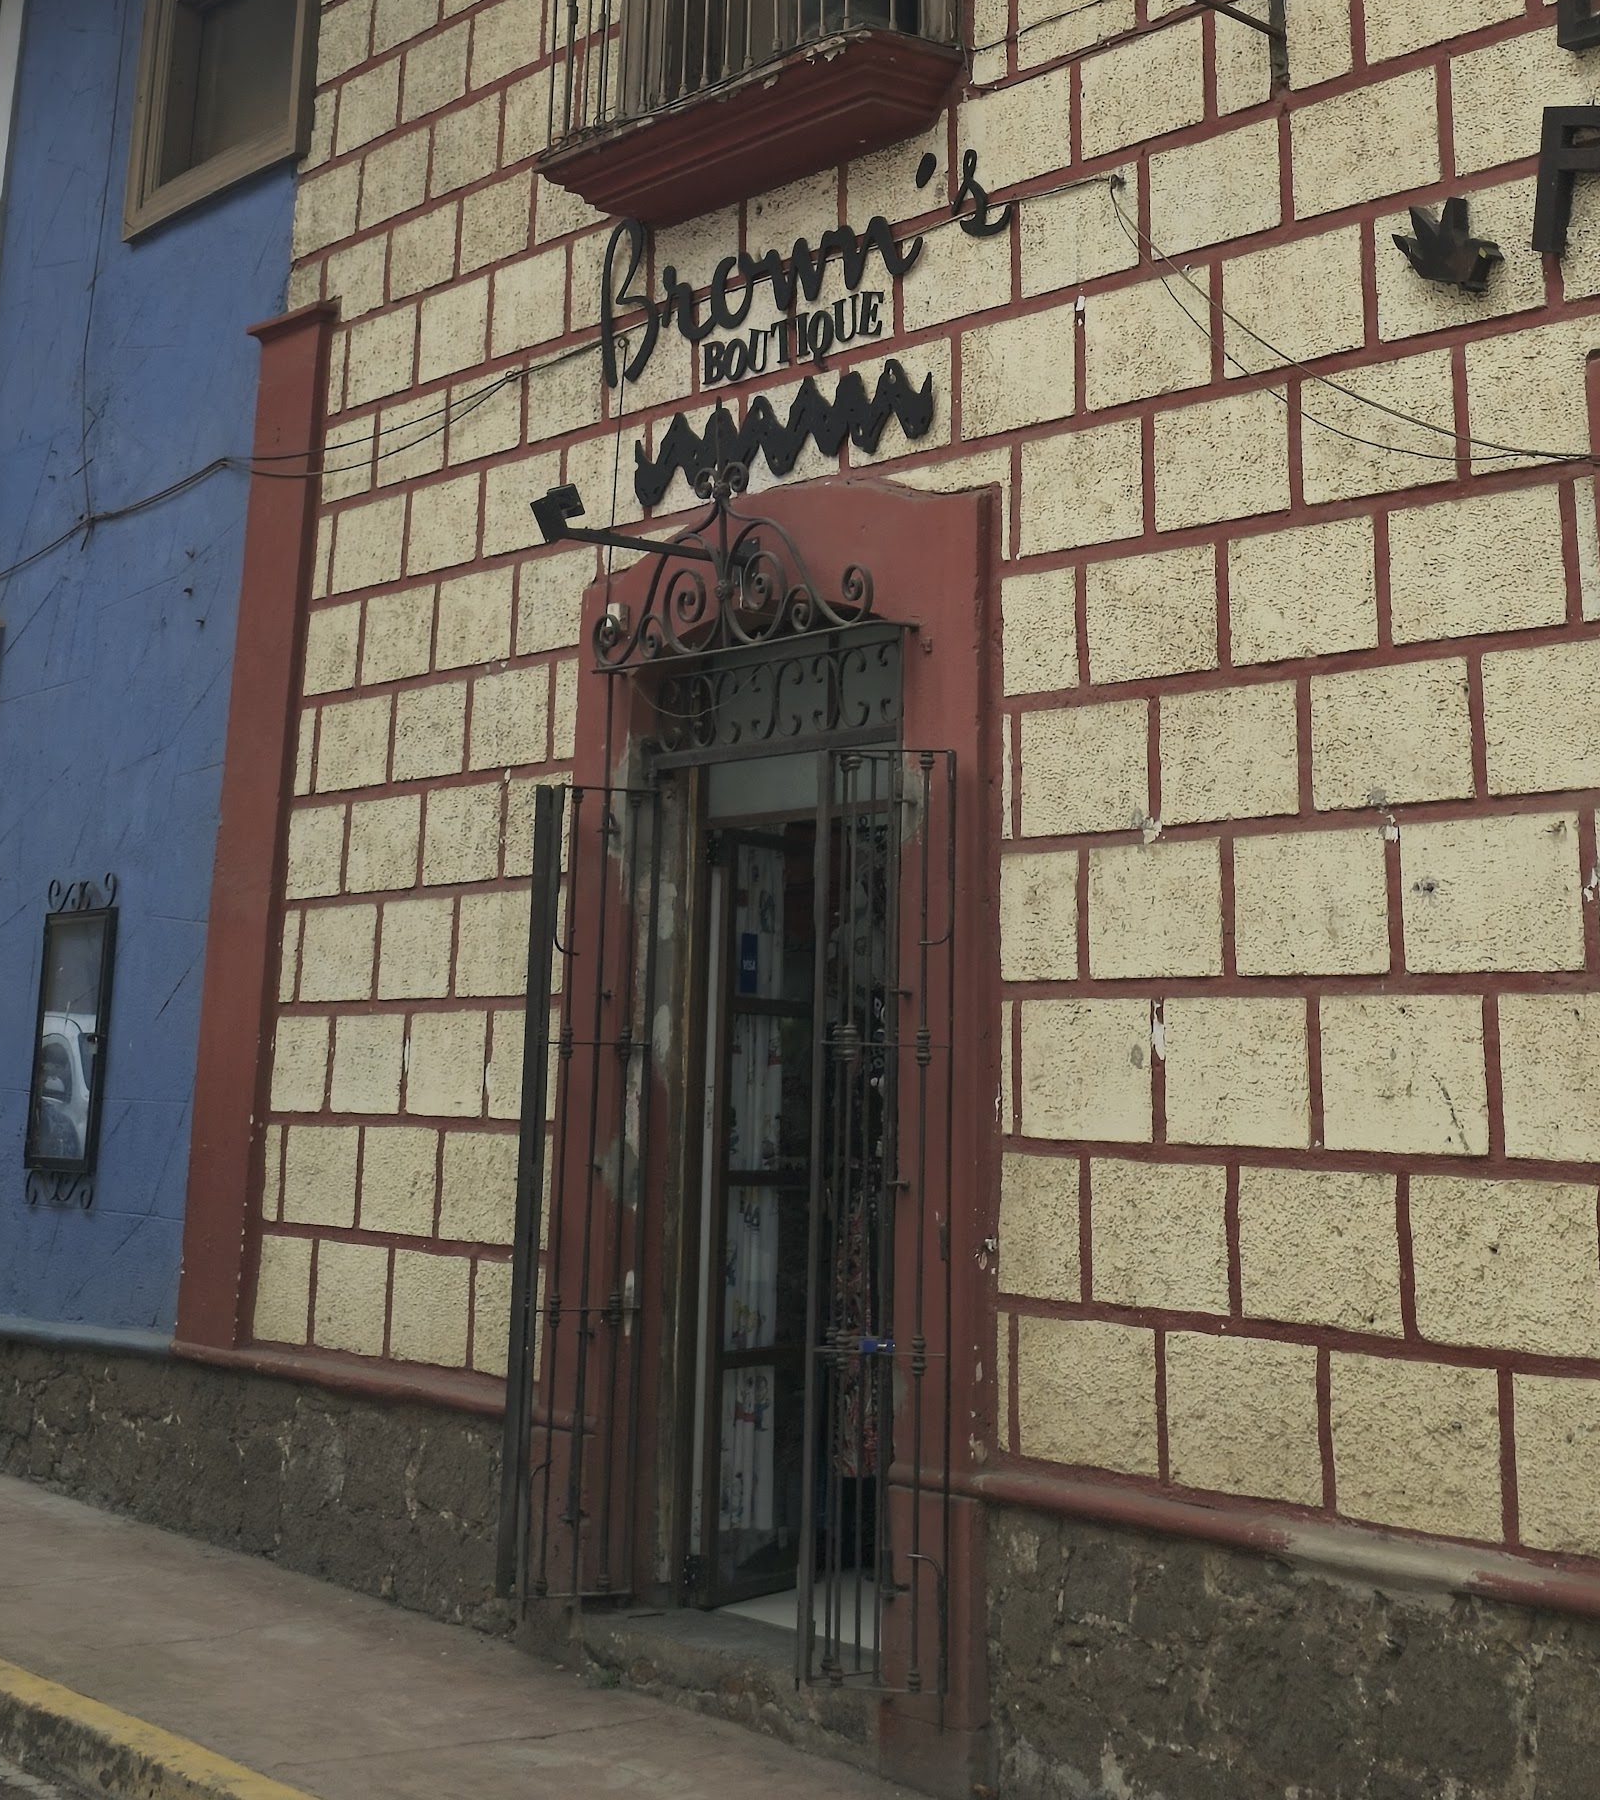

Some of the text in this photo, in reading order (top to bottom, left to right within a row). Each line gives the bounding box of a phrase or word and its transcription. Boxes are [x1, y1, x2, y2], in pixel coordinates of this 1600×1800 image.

[601, 149, 1012, 388] Brown's
[702, 290, 884, 386] BOUTIQUE
[742, 959, 756, 971] VISA
